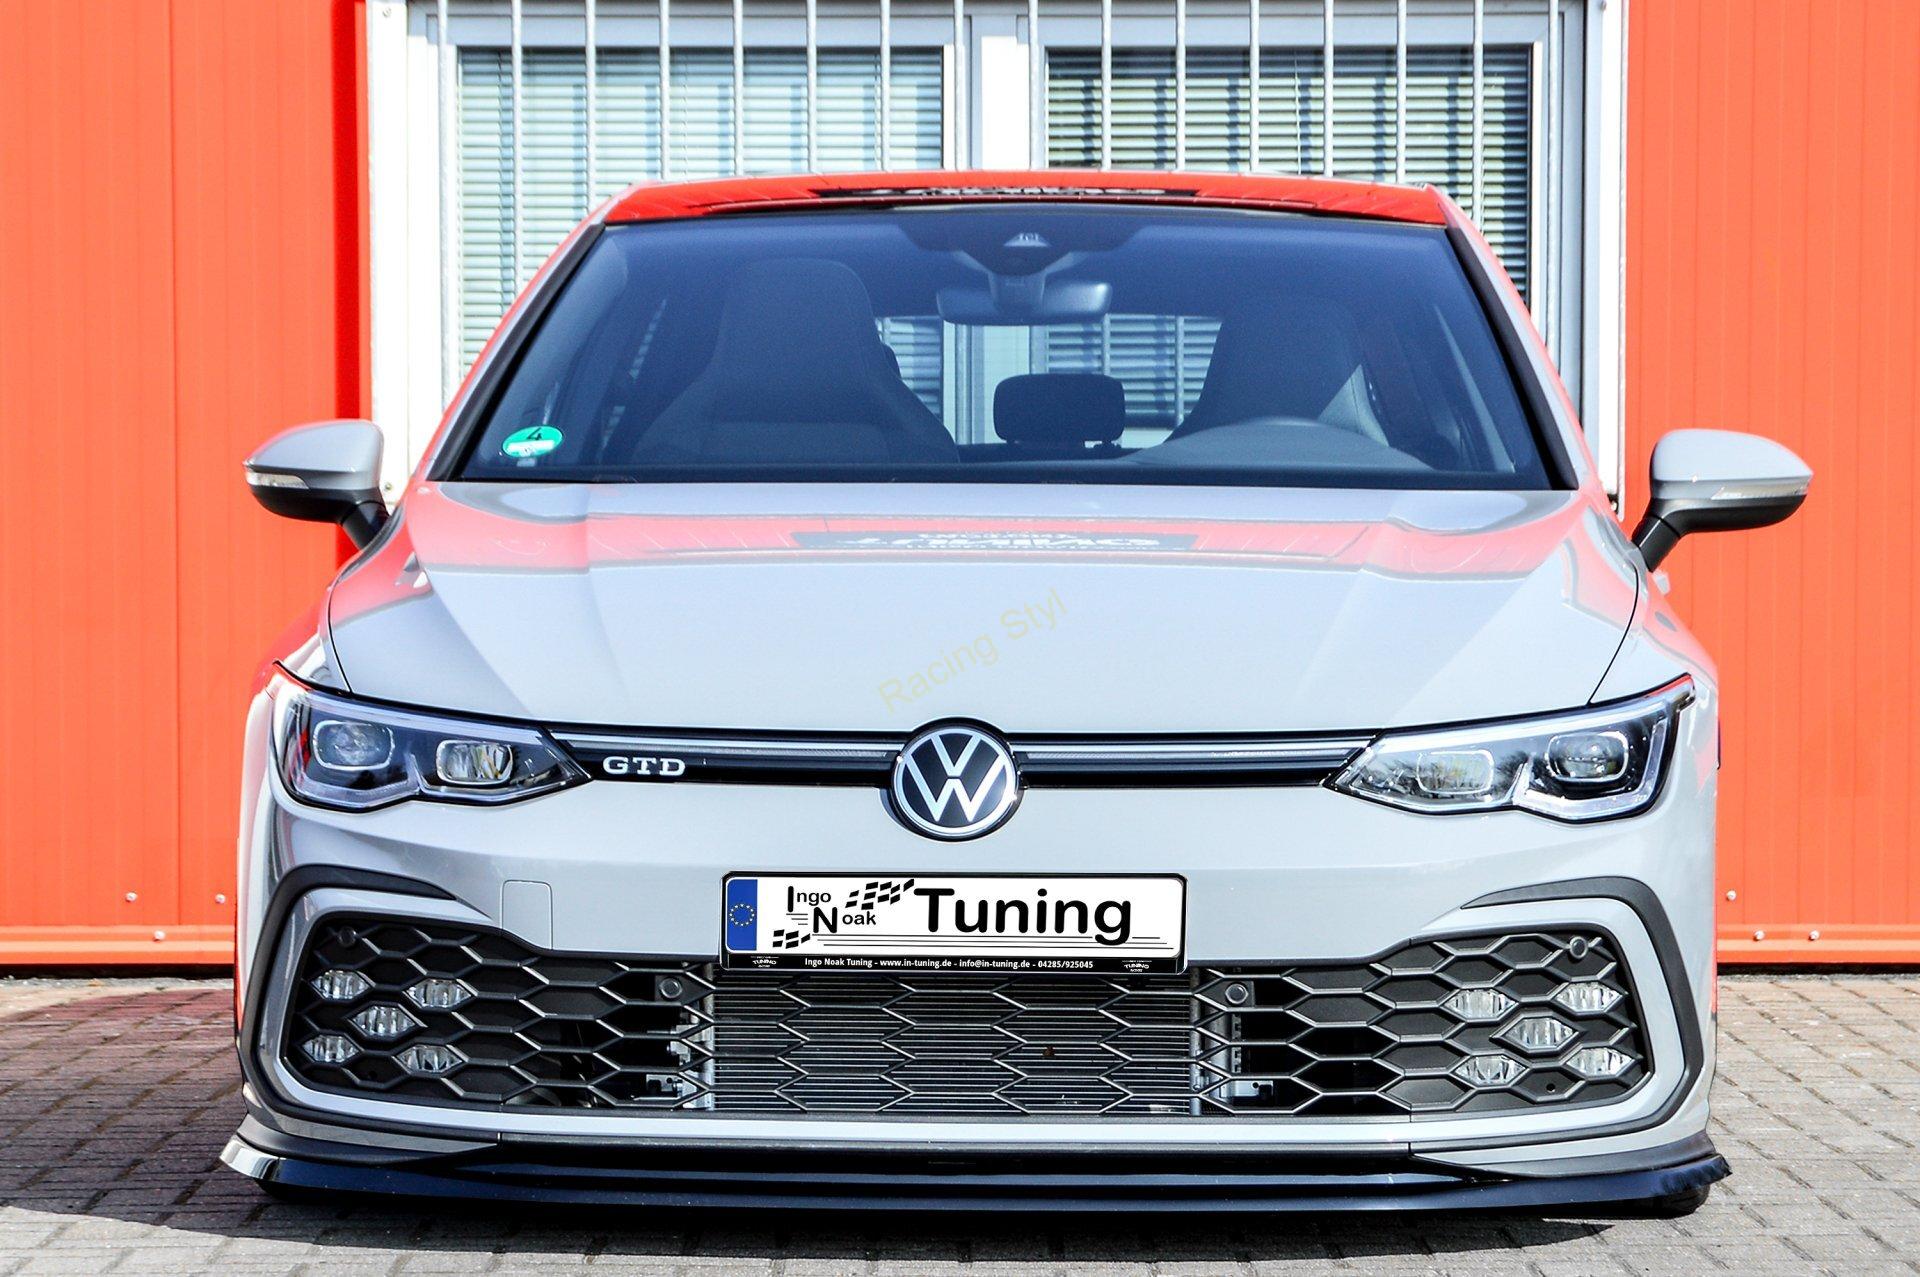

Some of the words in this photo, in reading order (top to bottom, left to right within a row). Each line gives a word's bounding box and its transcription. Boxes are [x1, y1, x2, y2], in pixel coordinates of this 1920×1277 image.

[527, 427, 542, 440] 4
[603, 756, 685, 776] GTD
[787, 885, 832, 912] Ingo
[813, 906, 877, 934] Noak
[913, 888, 1131, 946] Tuning
[805, 958, 822, 967] Ingo
[824, 958, 845, 966] Noak
[846, 958, 872, 968] Tuning
[880, 959, 952, 969] www.in-tuning.de
[959, 959, 1030, 969] info@in-tuning.de
[1038, 960, 1094, 969] 04285/925045
